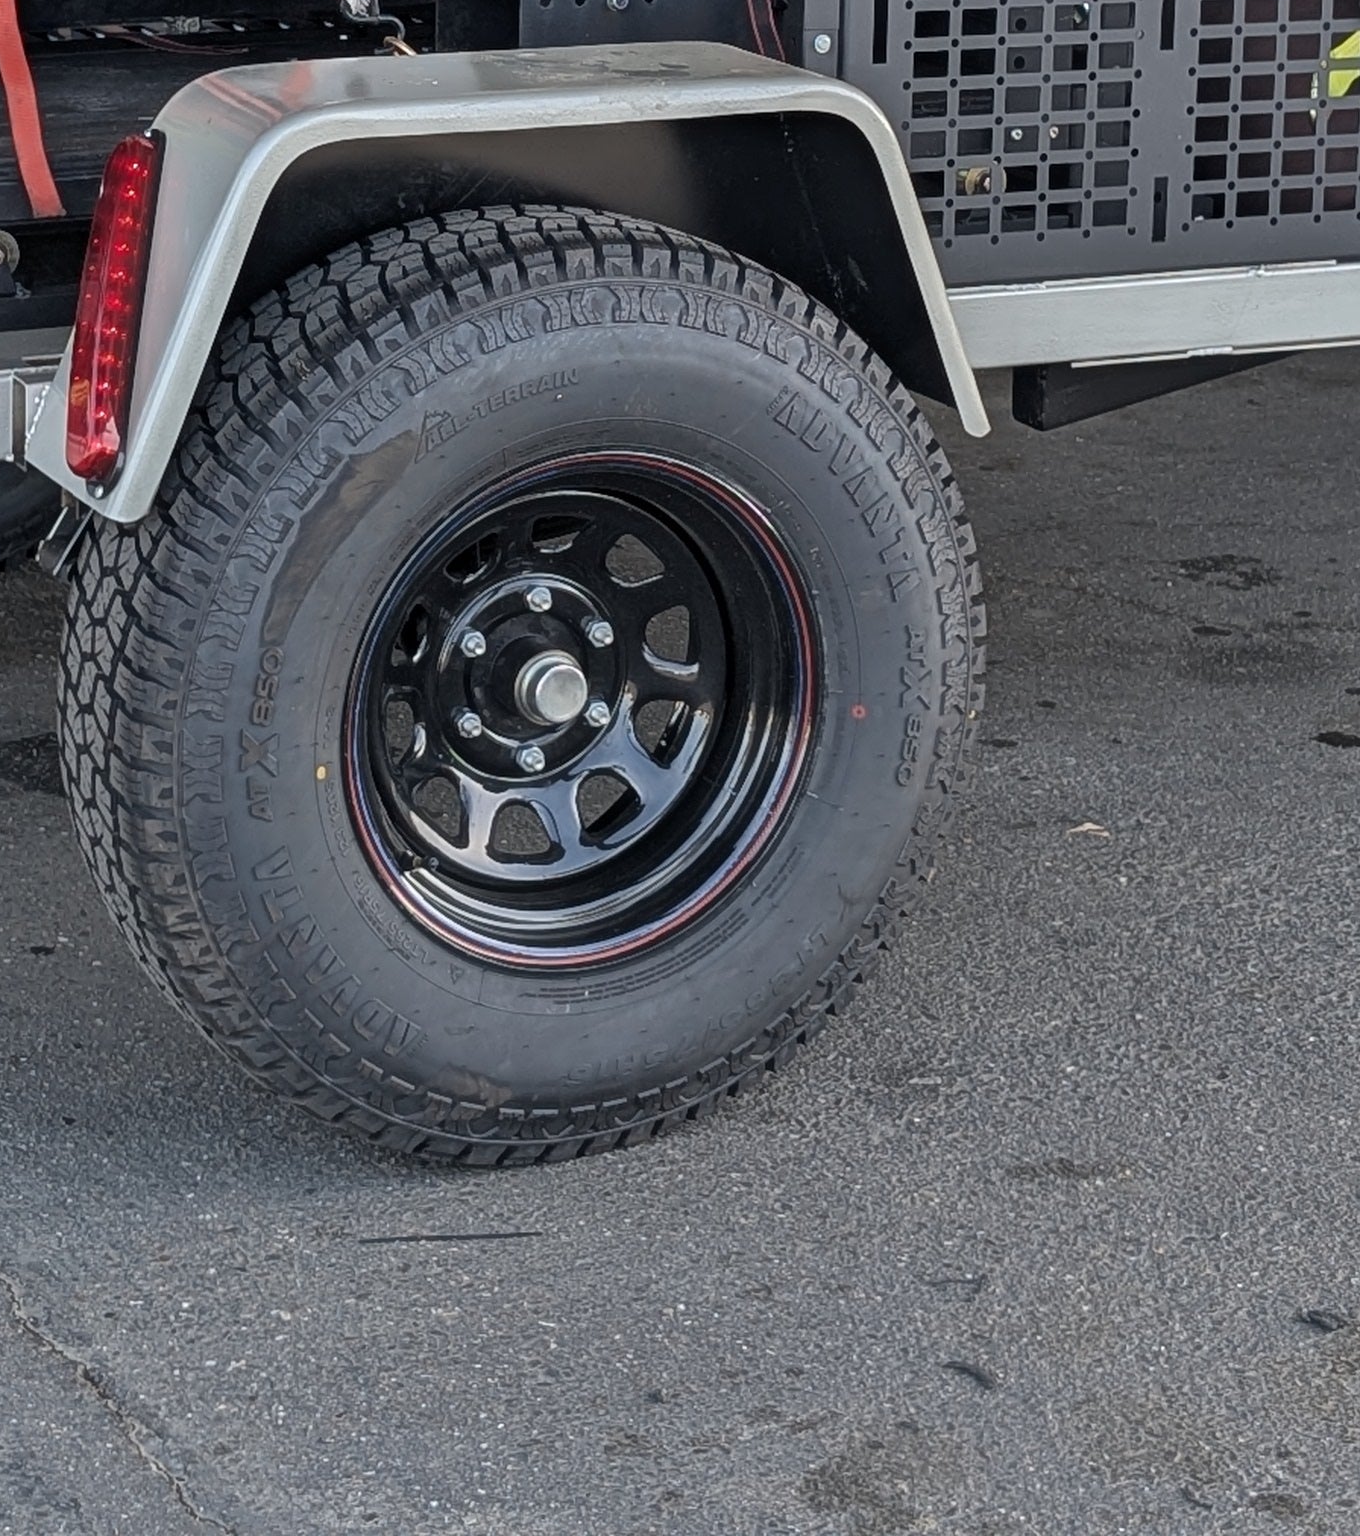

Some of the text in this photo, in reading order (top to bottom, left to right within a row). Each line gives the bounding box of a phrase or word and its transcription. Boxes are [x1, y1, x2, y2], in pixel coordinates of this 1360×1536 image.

[415, 367, 580, 462] ALL-TERRAIN
[772, 390, 922, 603] ADVANTA
[896, 714, 923, 787] 850
[250, 645, 286, 728] 850
[251, 845, 423, 1057] ADVANTA
